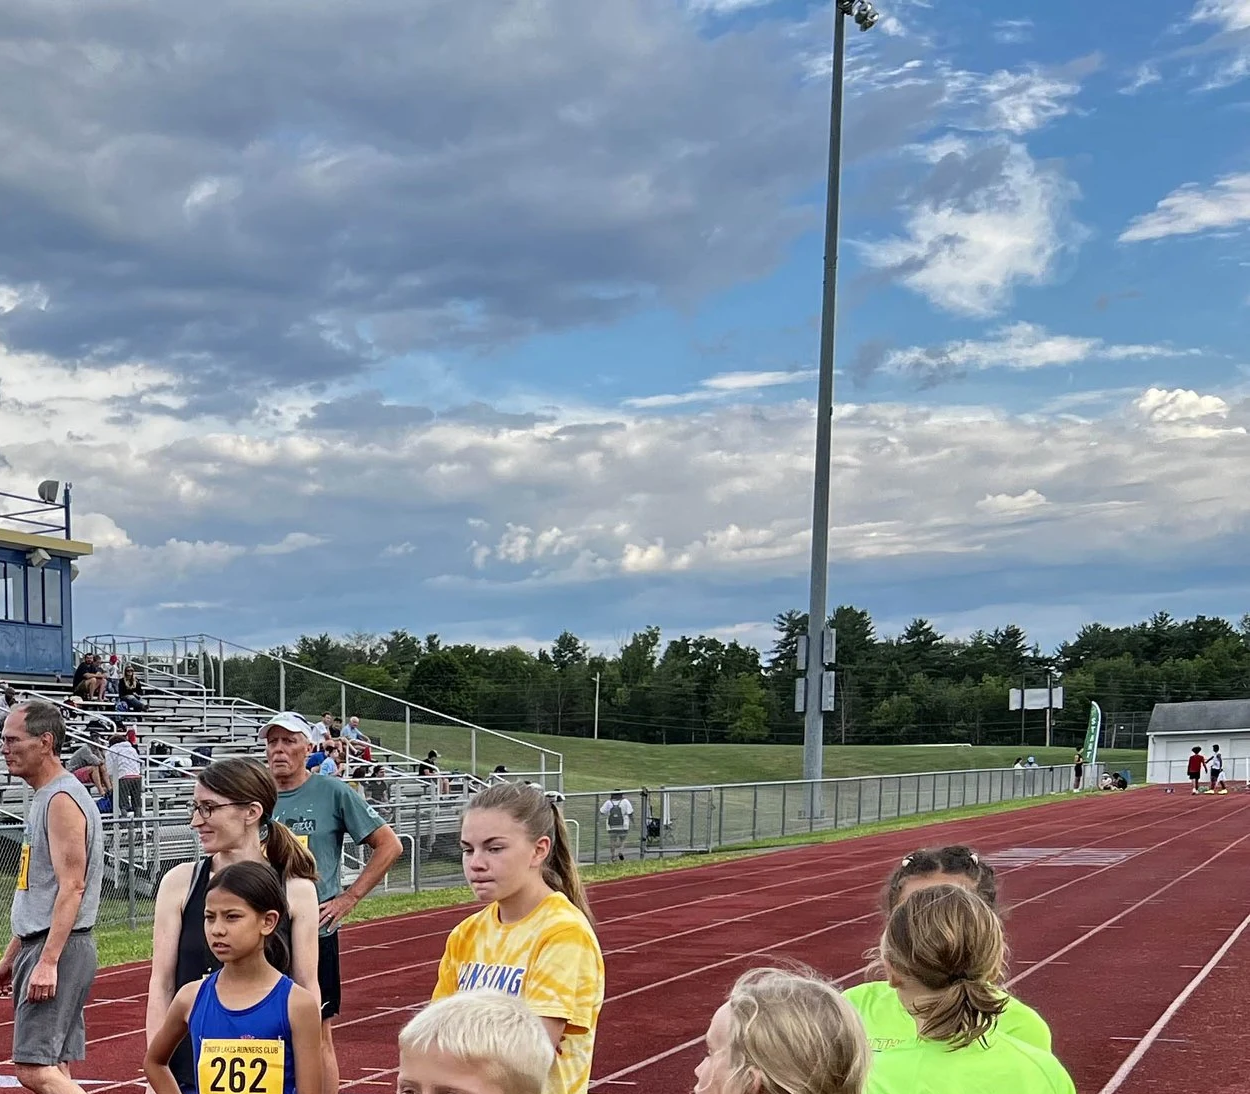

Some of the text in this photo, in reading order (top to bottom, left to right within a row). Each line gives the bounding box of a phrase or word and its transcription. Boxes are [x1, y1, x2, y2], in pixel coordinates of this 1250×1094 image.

[1086, 717, 1097, 759] START
[263, 1046, 279, 1054] CLUB
[210, 1057, 268, 1093] 262
